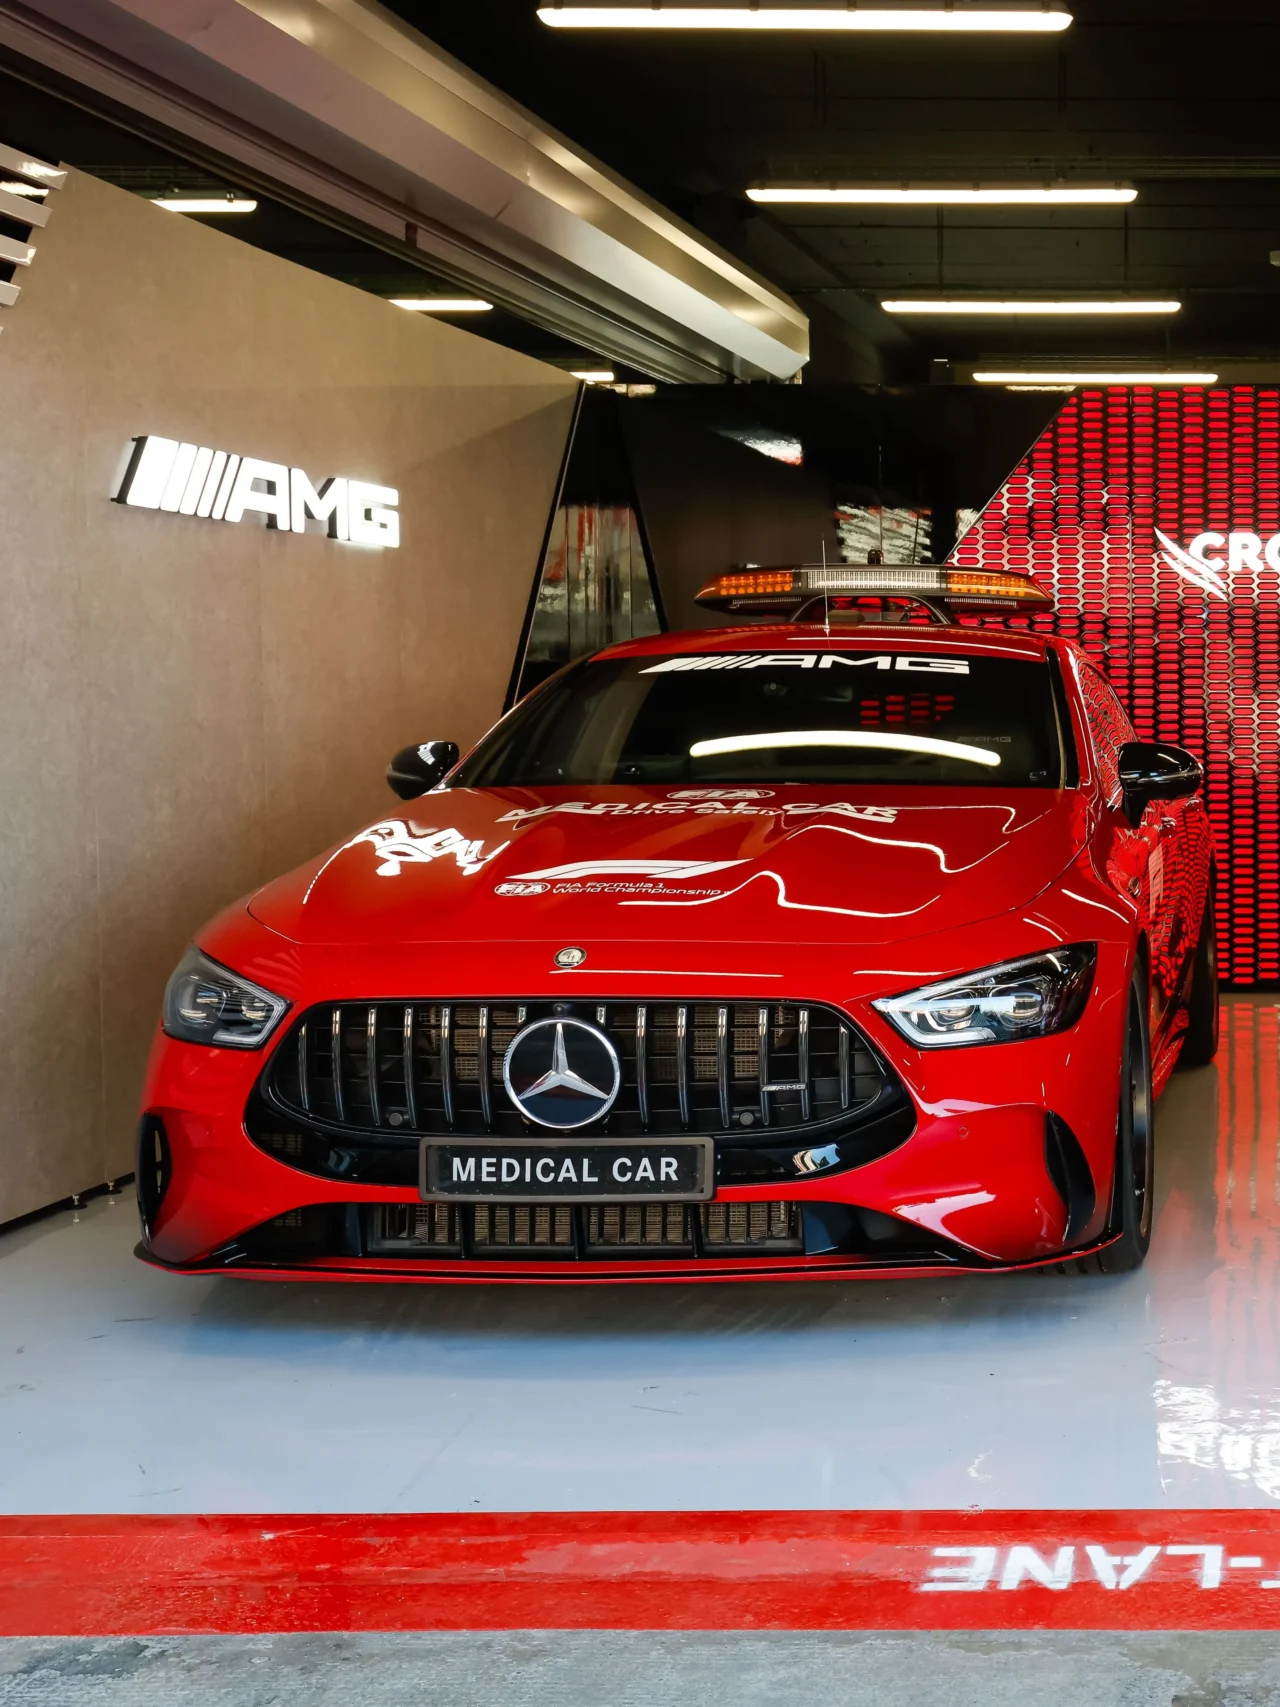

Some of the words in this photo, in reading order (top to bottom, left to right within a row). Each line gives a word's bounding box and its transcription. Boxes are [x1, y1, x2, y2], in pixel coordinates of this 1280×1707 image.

[225, 457, 400, 548] AMG
[739, 654, 970, 674] AMG
[499, 801, 761, 819] MEDICAL
[781, 802, 899, 818] CAR
[693, 808, 784, 816] Safely
[500, 884, 545, 895] FIA
[603, 887, 722, 896] Championship
[451, 1157, 599, 1183] MEDICAL
[611, 1156, 679, 1182] CAR
